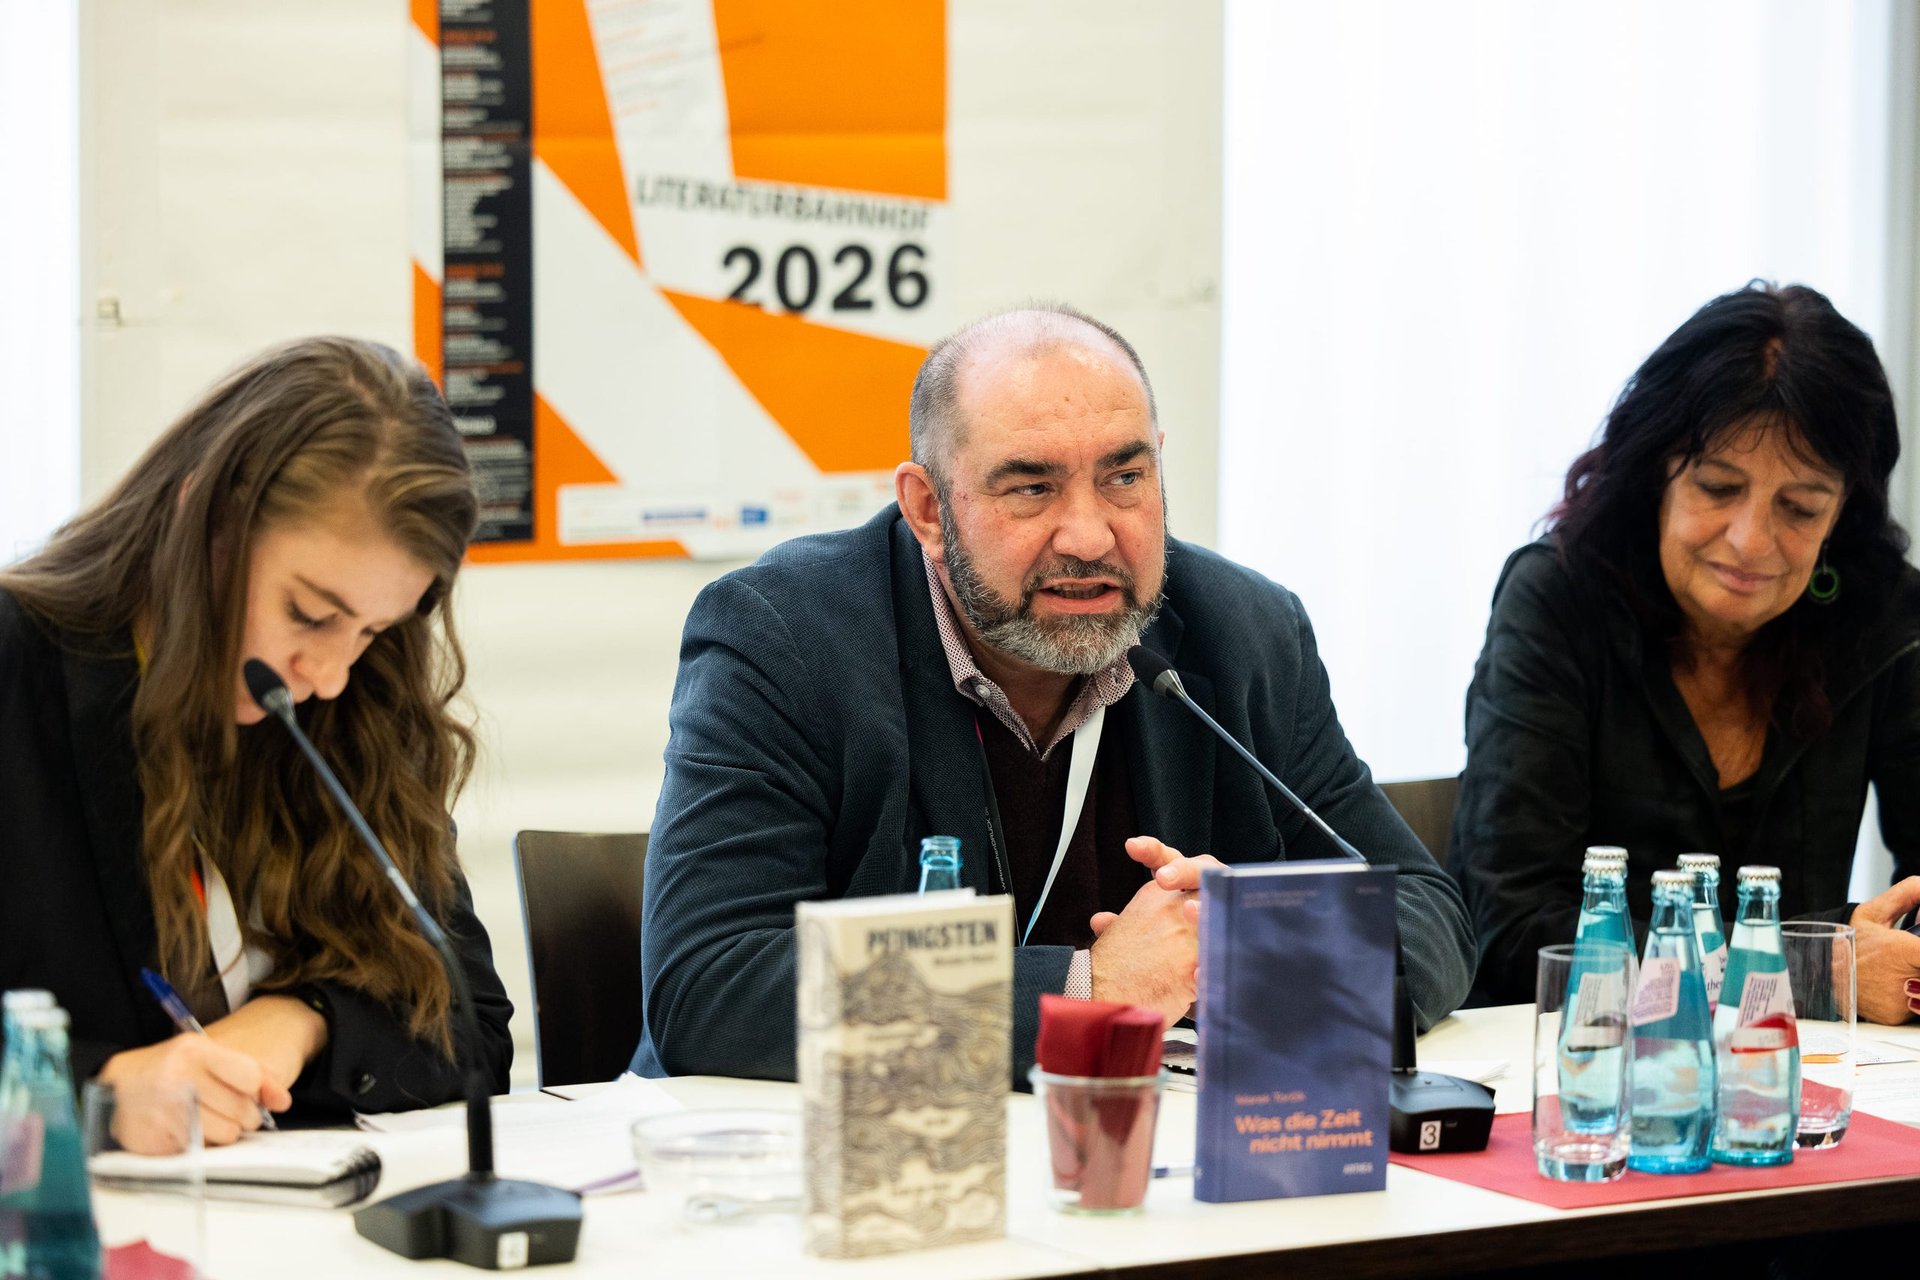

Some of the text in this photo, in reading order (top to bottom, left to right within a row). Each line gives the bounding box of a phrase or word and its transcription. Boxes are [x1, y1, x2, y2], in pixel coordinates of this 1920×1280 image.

[635, 174, 930, 231] LITERATURBAHNHOF
[722, 242, 930, 313] 2026
[1234, 1108, 1361, 1134] Was die Zeit
[1249, 1129, 1374, 1154] nicht nimmt
[1423, 1123, 1437, 1146] 3
